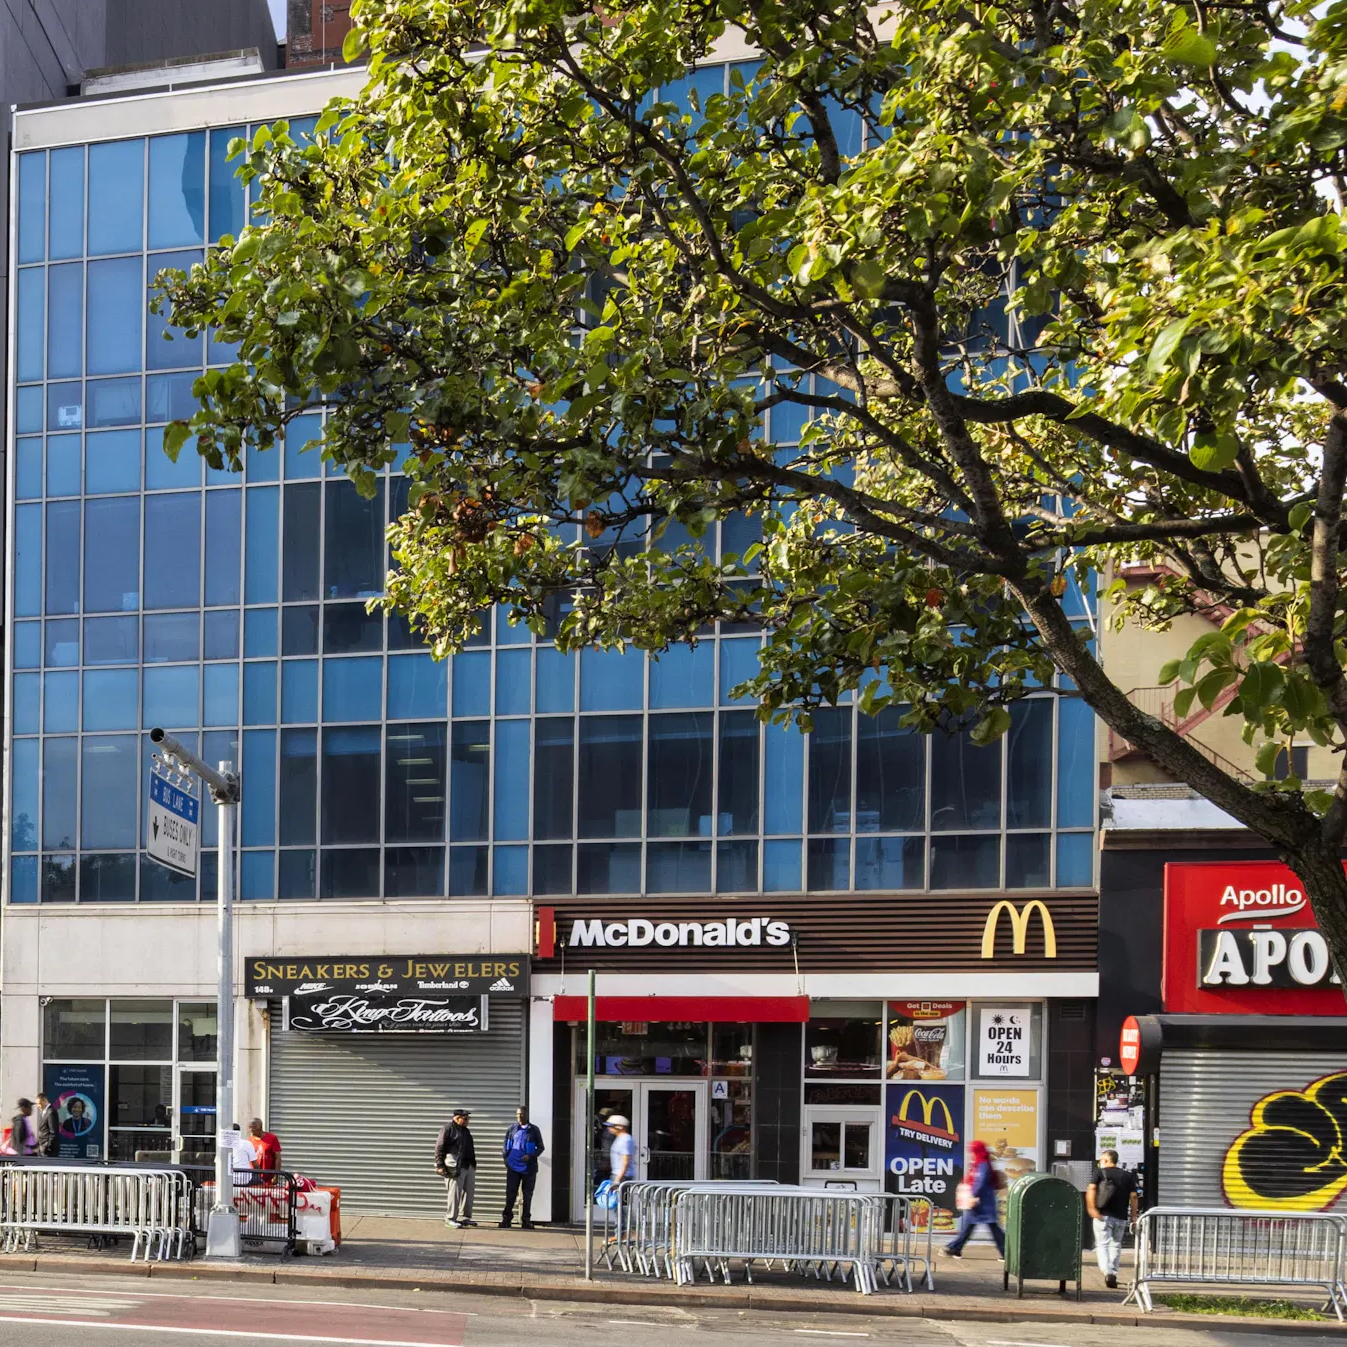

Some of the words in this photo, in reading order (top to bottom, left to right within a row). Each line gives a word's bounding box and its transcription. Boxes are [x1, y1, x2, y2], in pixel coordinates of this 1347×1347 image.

[162, 786, 171, 805] BUS
[172, 793, 184, 812] LANE
[163, 815, 179, 842] BUSES
[179, 824, 193, 847] ONLY
[1220, 884, 1302, 910] Apollo
[569, 918, 791, 946] McDonald's
[1203, 931, 1341, 985] APO
[253, 961, 370, 980] SNEAKERS
[377, 964, 393, 978] &
[402, 959, 520, 979] JEWELERS
[300, 982, 327, 990] NIKE
[417, 981, 459, 989] Timberland
[299, 995, 388, 1027] King
[384, 998, 478, 1027] Tattoos
[988, 1027, 1022, 1040] OPEN
[996, 1041, 1013, 1054] 24
[987, 1054, 1022, 1064] Hours
[715, 1082, 725, 1094] A
[997, 1104, 1035, 1112] describe
[900, 1127, 916, 1139] TRY
[916, 1132, 953, 1149] DELIVERY
[890, 1157, 954, 1175] OPEN
[898, 1176, 947, 1193] Late
